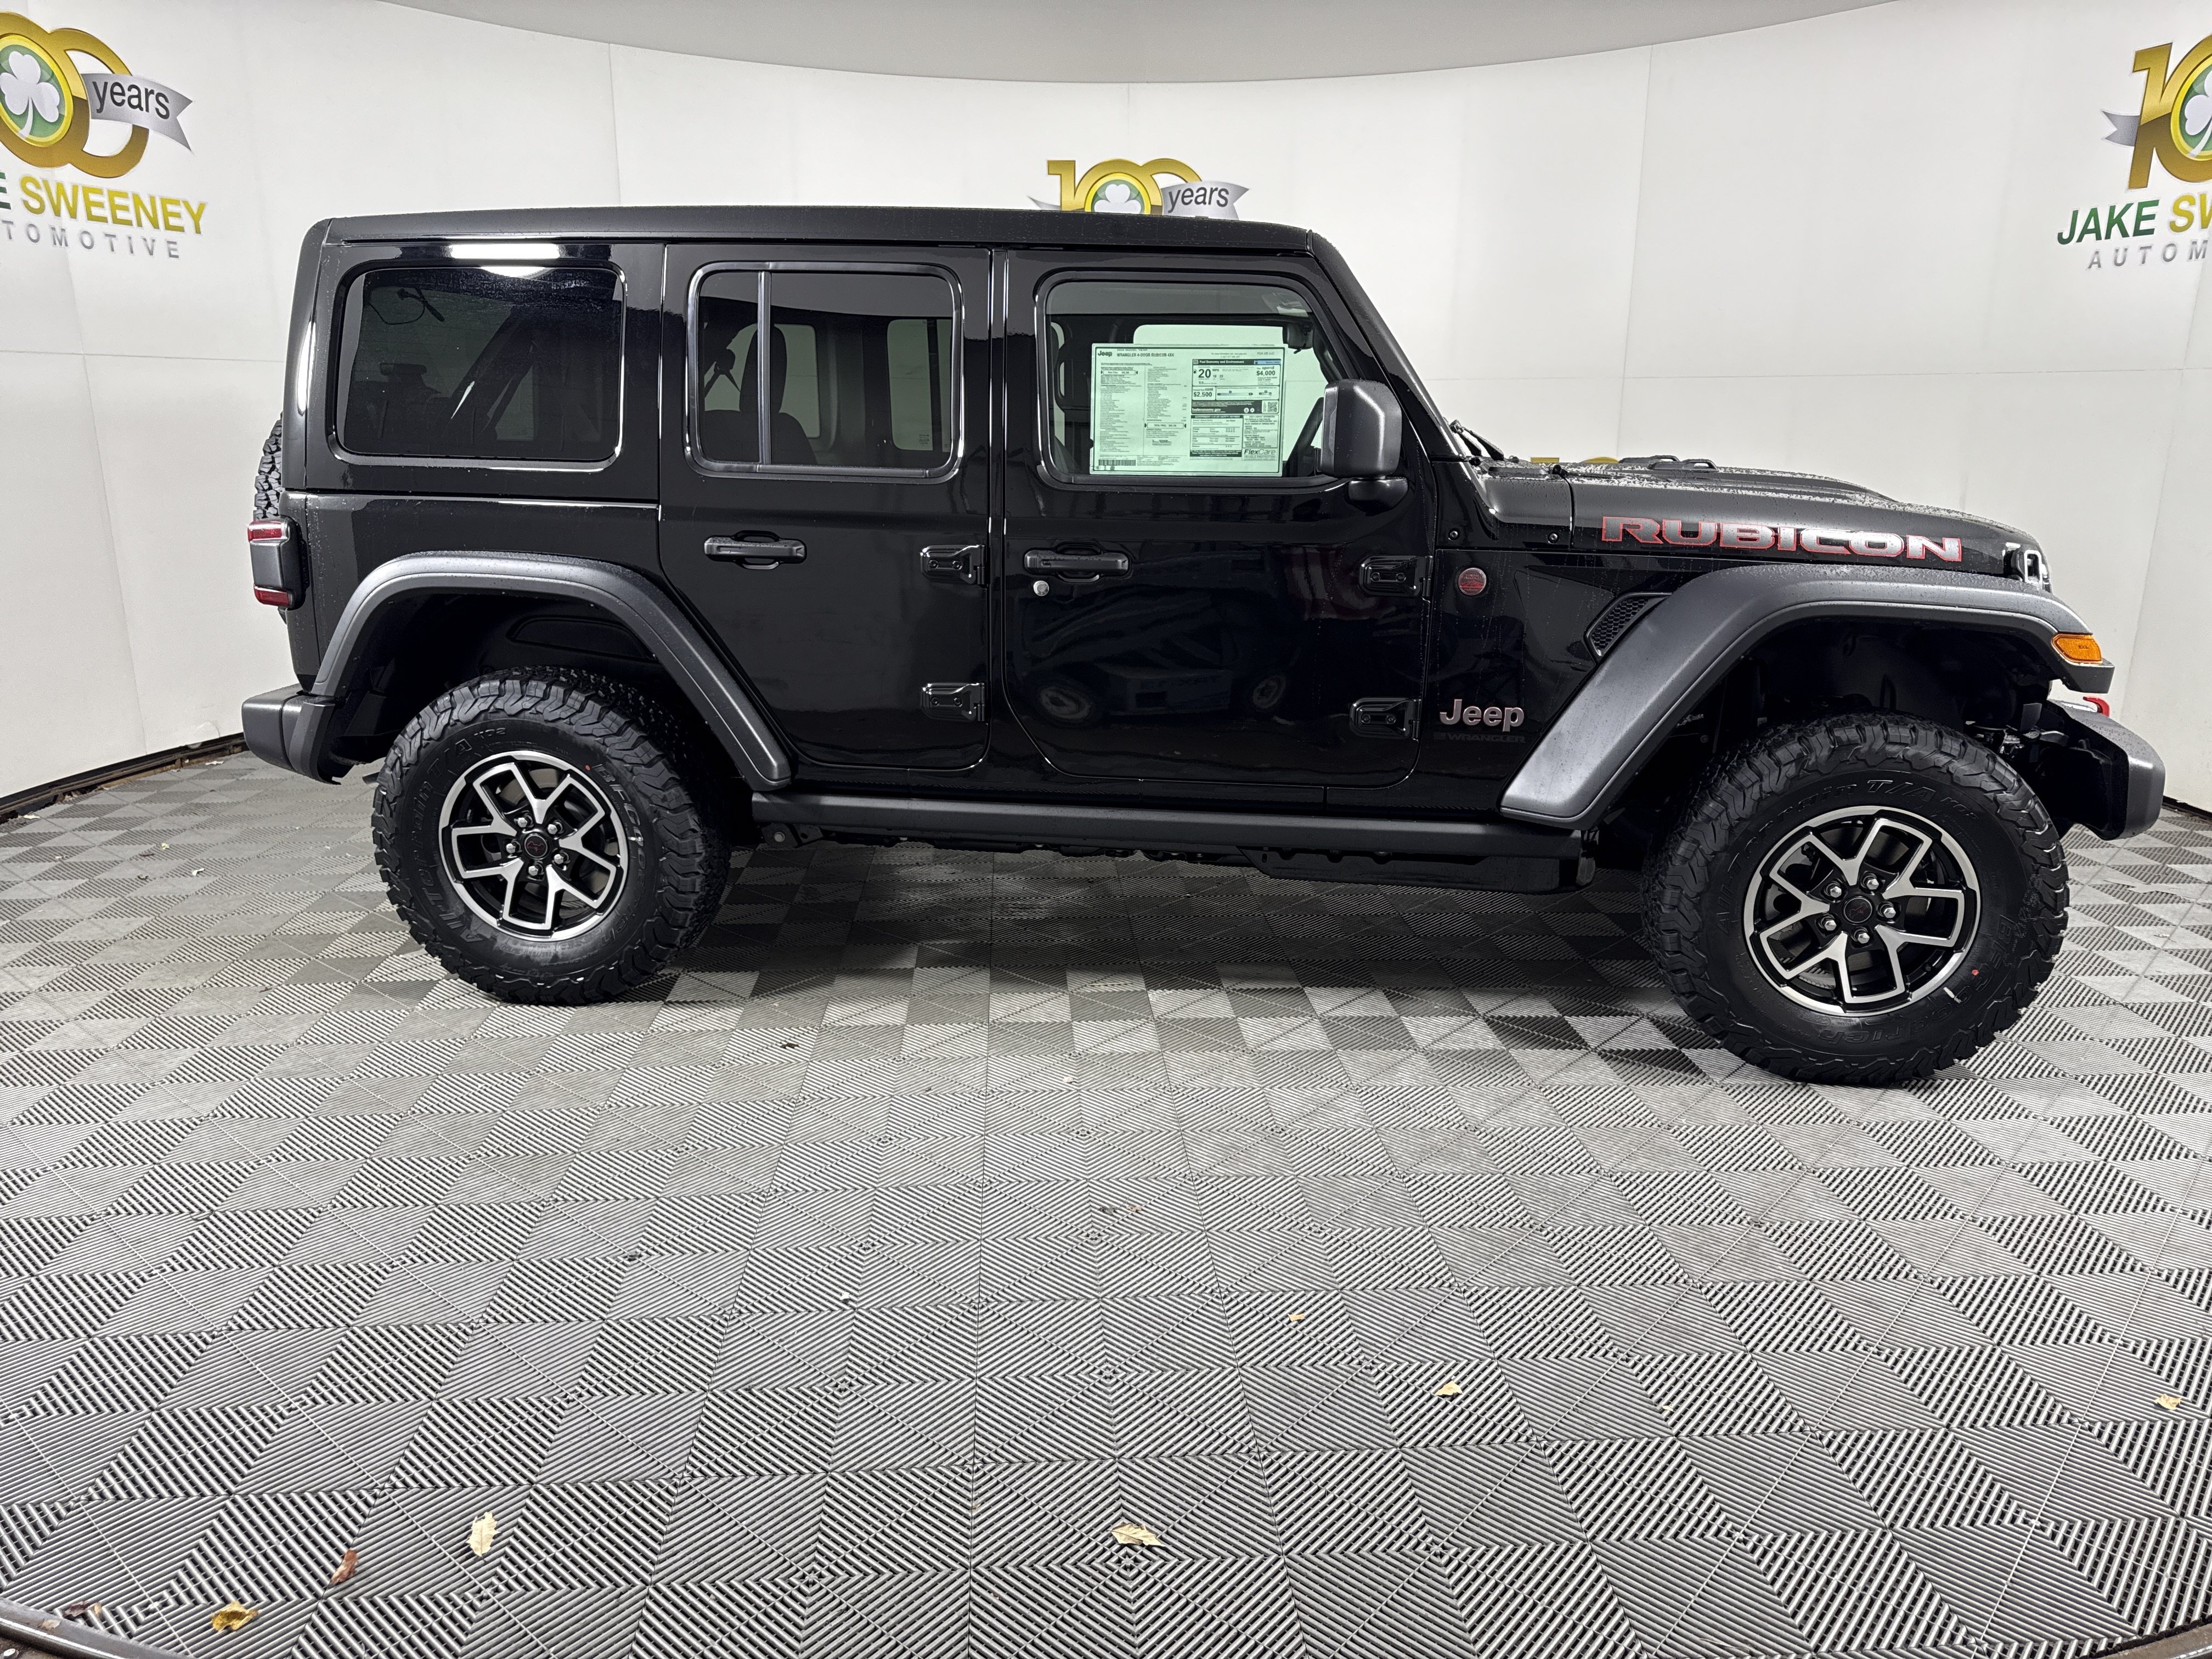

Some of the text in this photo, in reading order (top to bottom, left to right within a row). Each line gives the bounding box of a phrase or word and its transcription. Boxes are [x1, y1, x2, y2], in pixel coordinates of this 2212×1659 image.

[92, 81, 170, 120] years
[20, 176, 207, 235] SWEENEY
[1168, 187, 1229, 213] years
[2057, 199, 2160, 245] JAKE
[1198, 369, 1211, 378] 20
[1601, 516, 1962, 562] RUBICON
[1439, 698, 1525, 732] Jeep
[1447, 732, 1527, 743] WRANGLER
[1867, 779, 1937, 802] T/A
